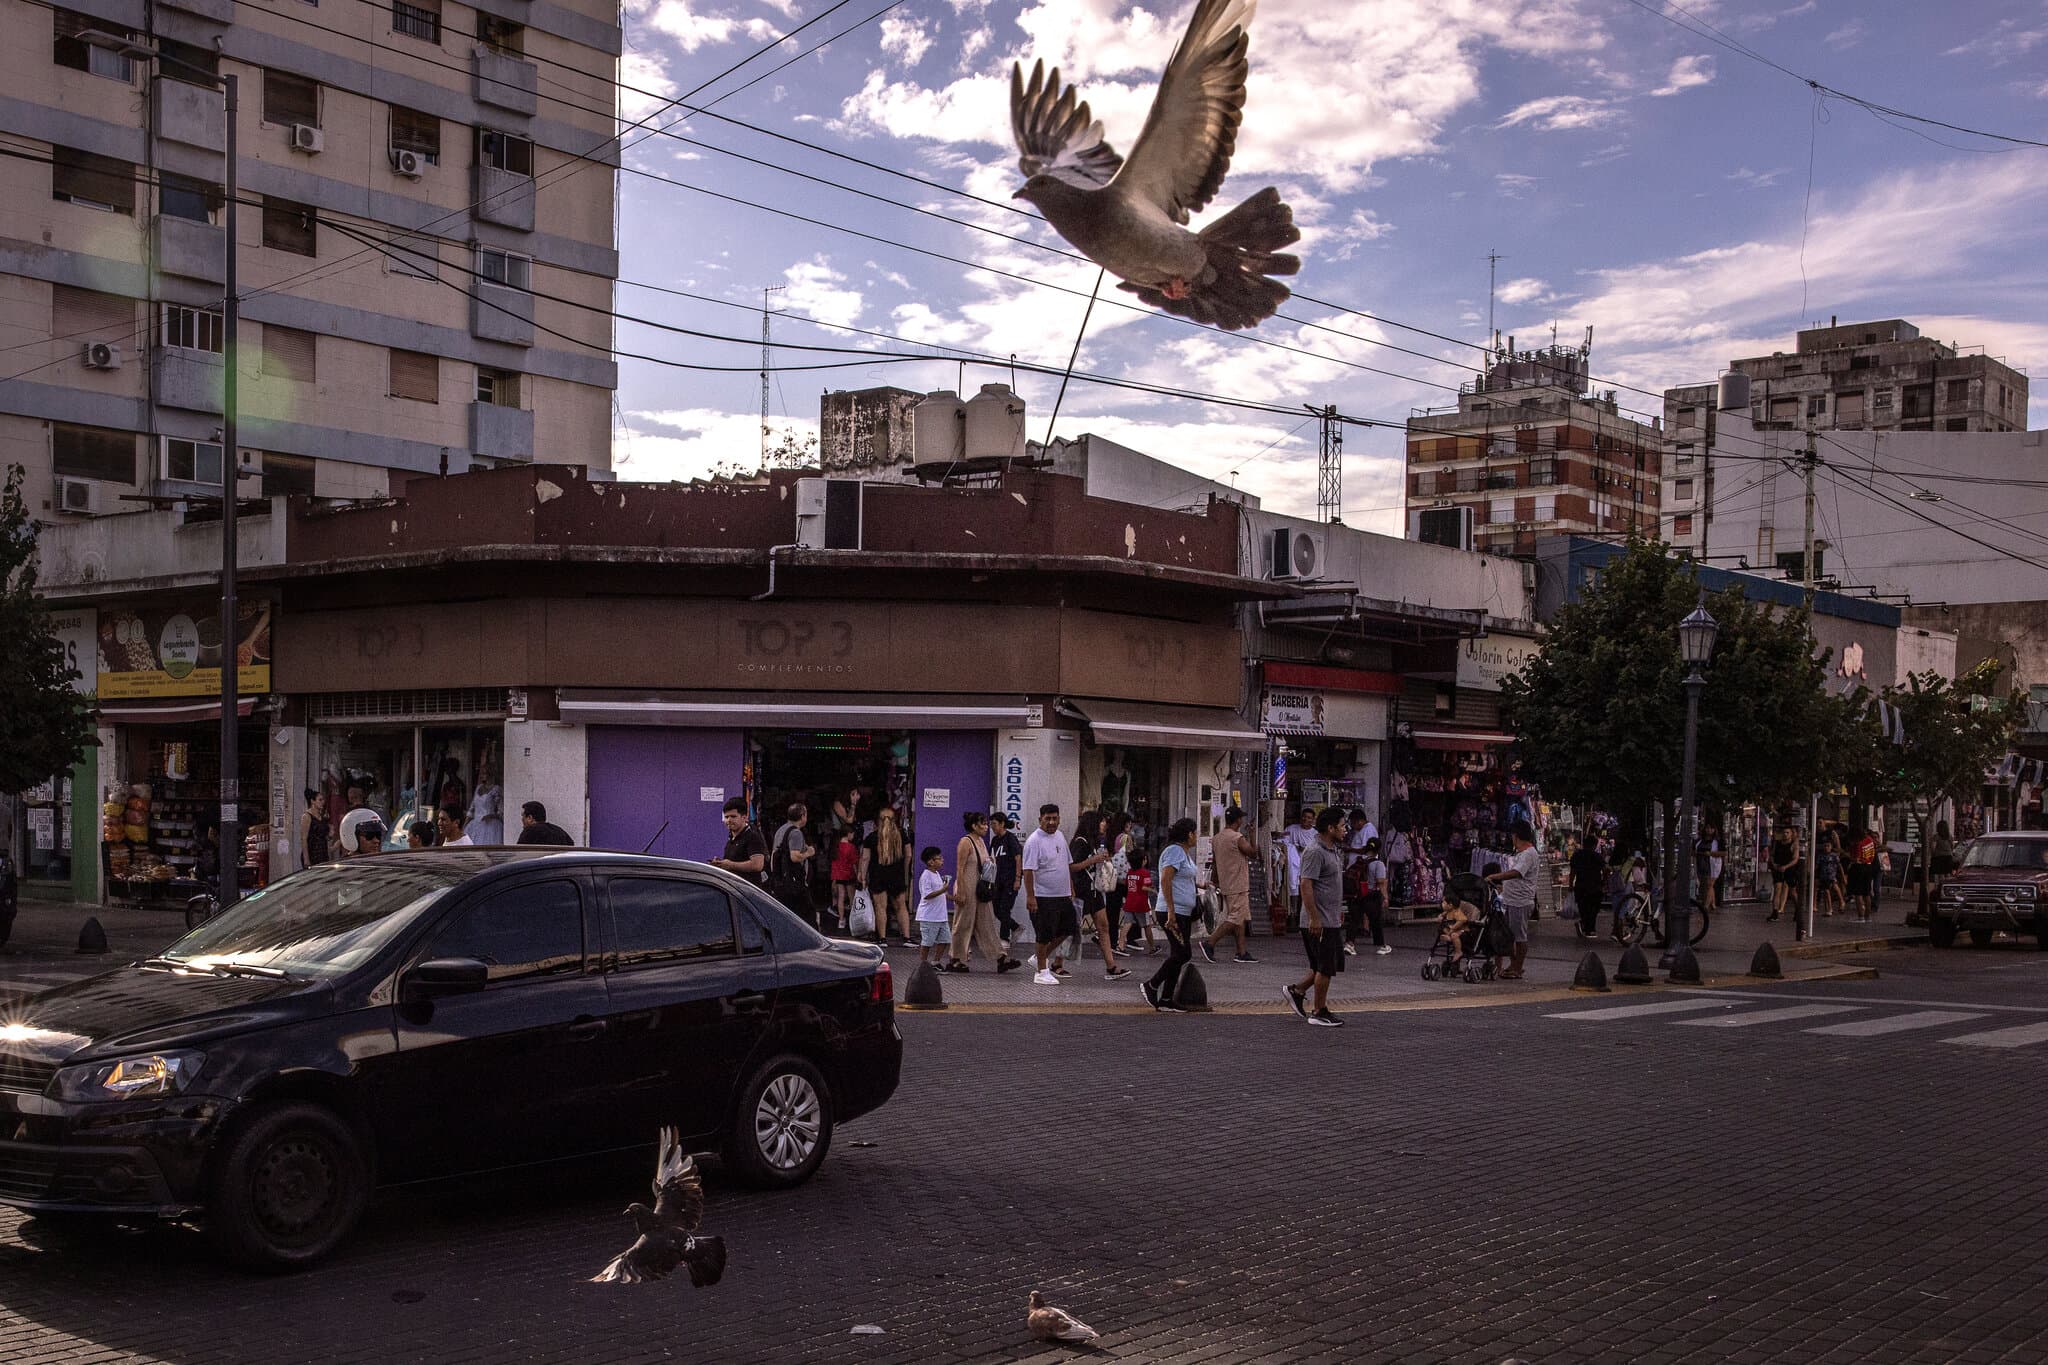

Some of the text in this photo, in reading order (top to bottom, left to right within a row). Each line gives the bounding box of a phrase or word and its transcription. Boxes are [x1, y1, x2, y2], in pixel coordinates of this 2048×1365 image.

[737, 619, 853, 656] TOP 3
[737, 664, 855, 673] COMPLEMENTOS
[1006, 757, 1023, 821] ABOGADA
